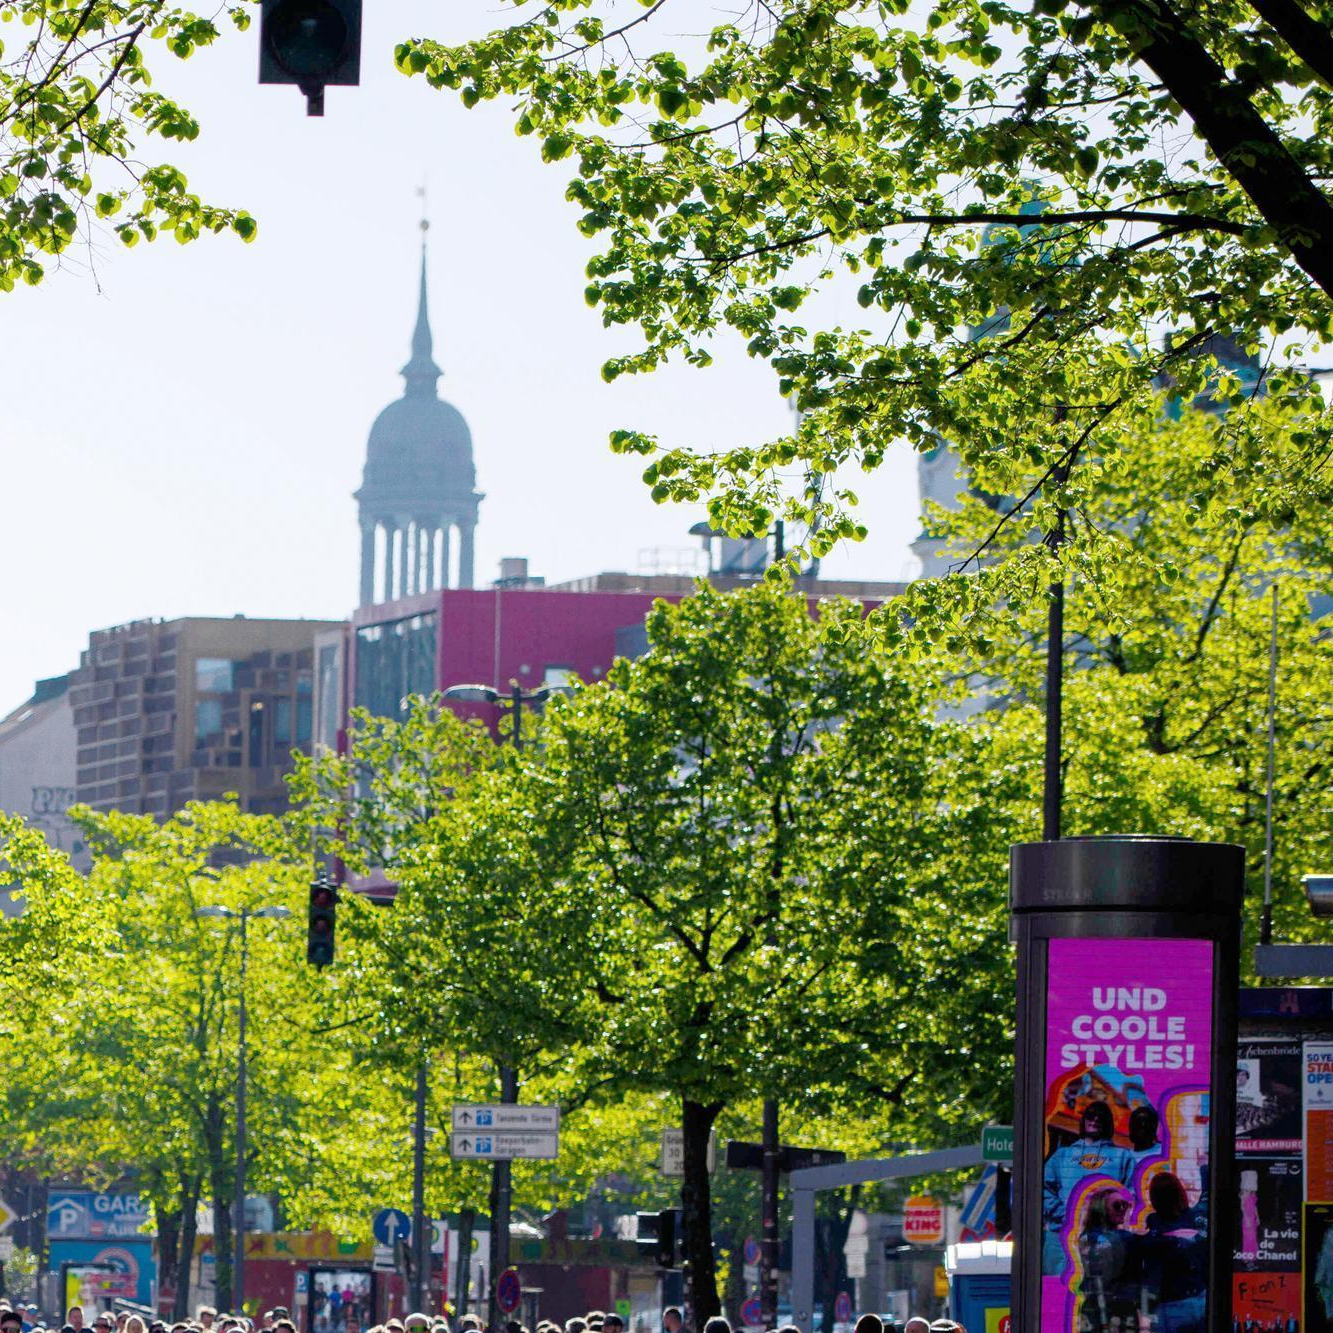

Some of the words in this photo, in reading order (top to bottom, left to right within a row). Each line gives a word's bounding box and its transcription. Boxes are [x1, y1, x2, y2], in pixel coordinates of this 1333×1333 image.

[1092, 987, 1167, 1012] UND
[1071, 1015, 1186, 1041] COOLE
[1060, 1044, 1195, 1070] STYLES!
[1321, 1053, 1333, 1063] YE
[904, 1220, 941, 1232] KING
[1263, 1227, 1279, 1239] La
[1281, 1227, 1299, 1239] vie
[1259, 1239, 1275, 1250] de
[1255, 1249, 1297, 1261] Chanel
